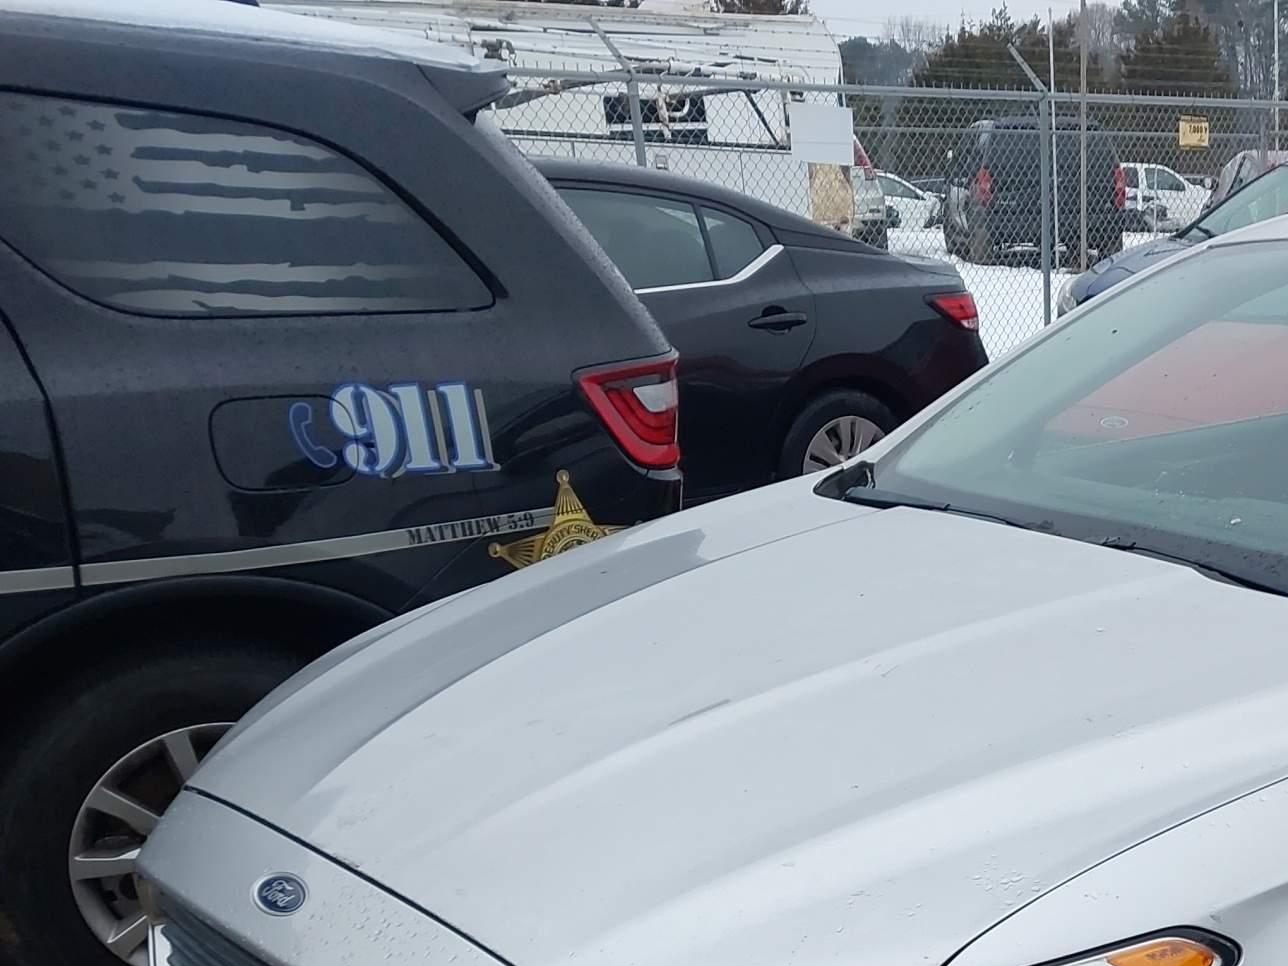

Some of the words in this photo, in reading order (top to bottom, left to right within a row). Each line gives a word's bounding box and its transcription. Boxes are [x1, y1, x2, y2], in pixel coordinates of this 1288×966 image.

[329, 381, 500, 479] 911
[407, 516, 500, 545] MATTHEW
[507, 512, 535, 530] 5:9
[262, 880, 296, 907] Ford
